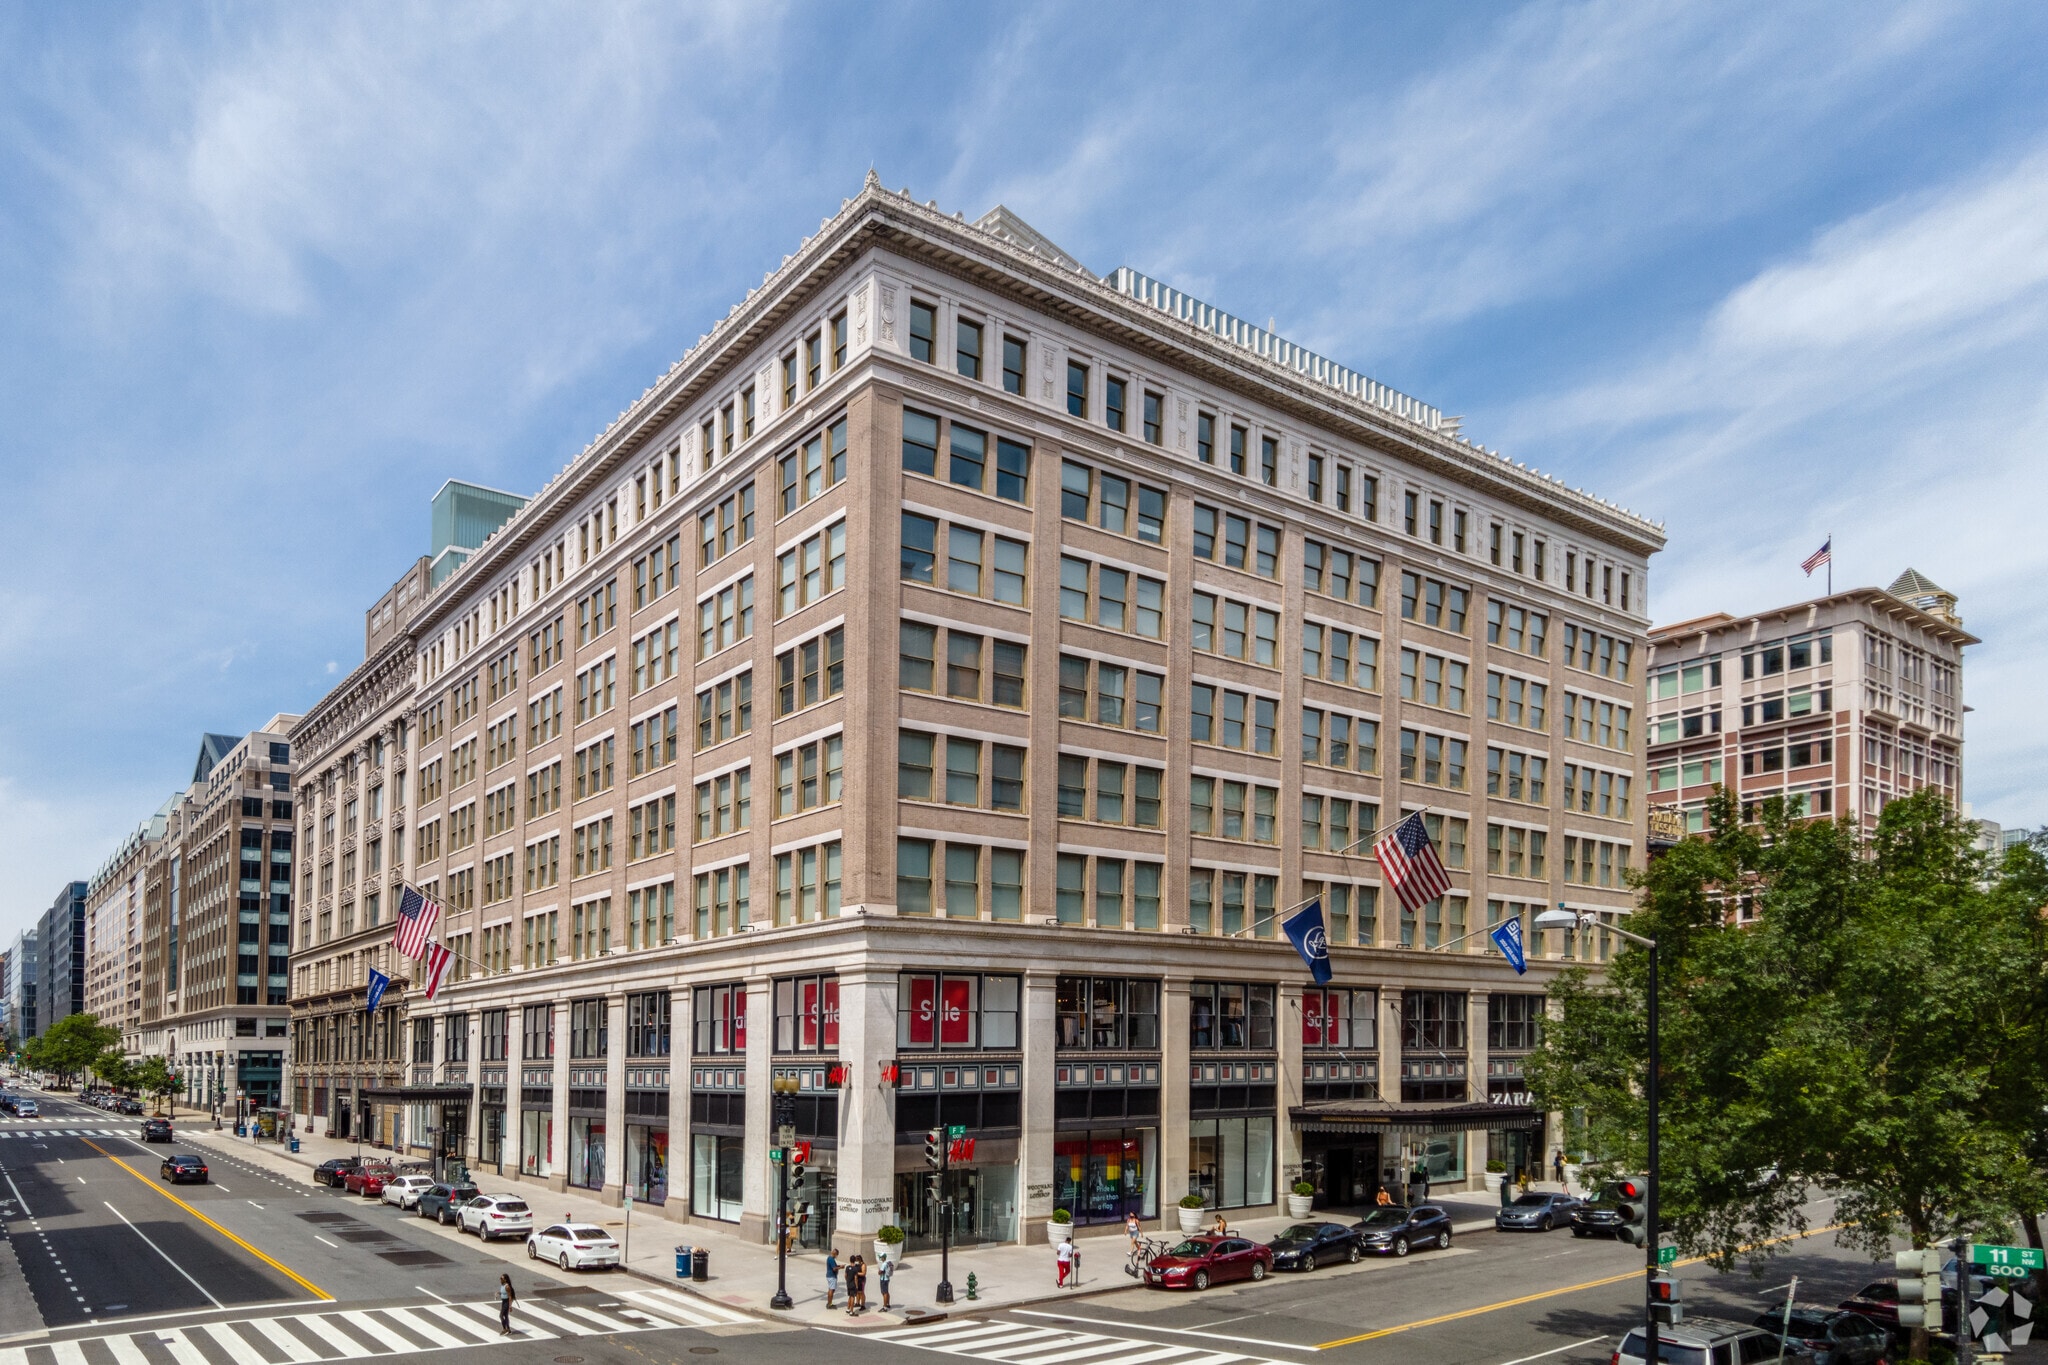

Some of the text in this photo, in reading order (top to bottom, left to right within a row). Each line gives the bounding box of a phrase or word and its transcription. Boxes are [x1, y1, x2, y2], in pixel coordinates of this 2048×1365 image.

[920, 1000, 960, 1021] Sle
[1307, 1010, 1333, 1027] Sae
[1490, 1088, 1535, 1105] ZARA
[1989, 1249, 2034, 1263] 11 ST
[2021, 1258, 2035, 1266] NW
[1990, 1264, 2025, 1277] 500
